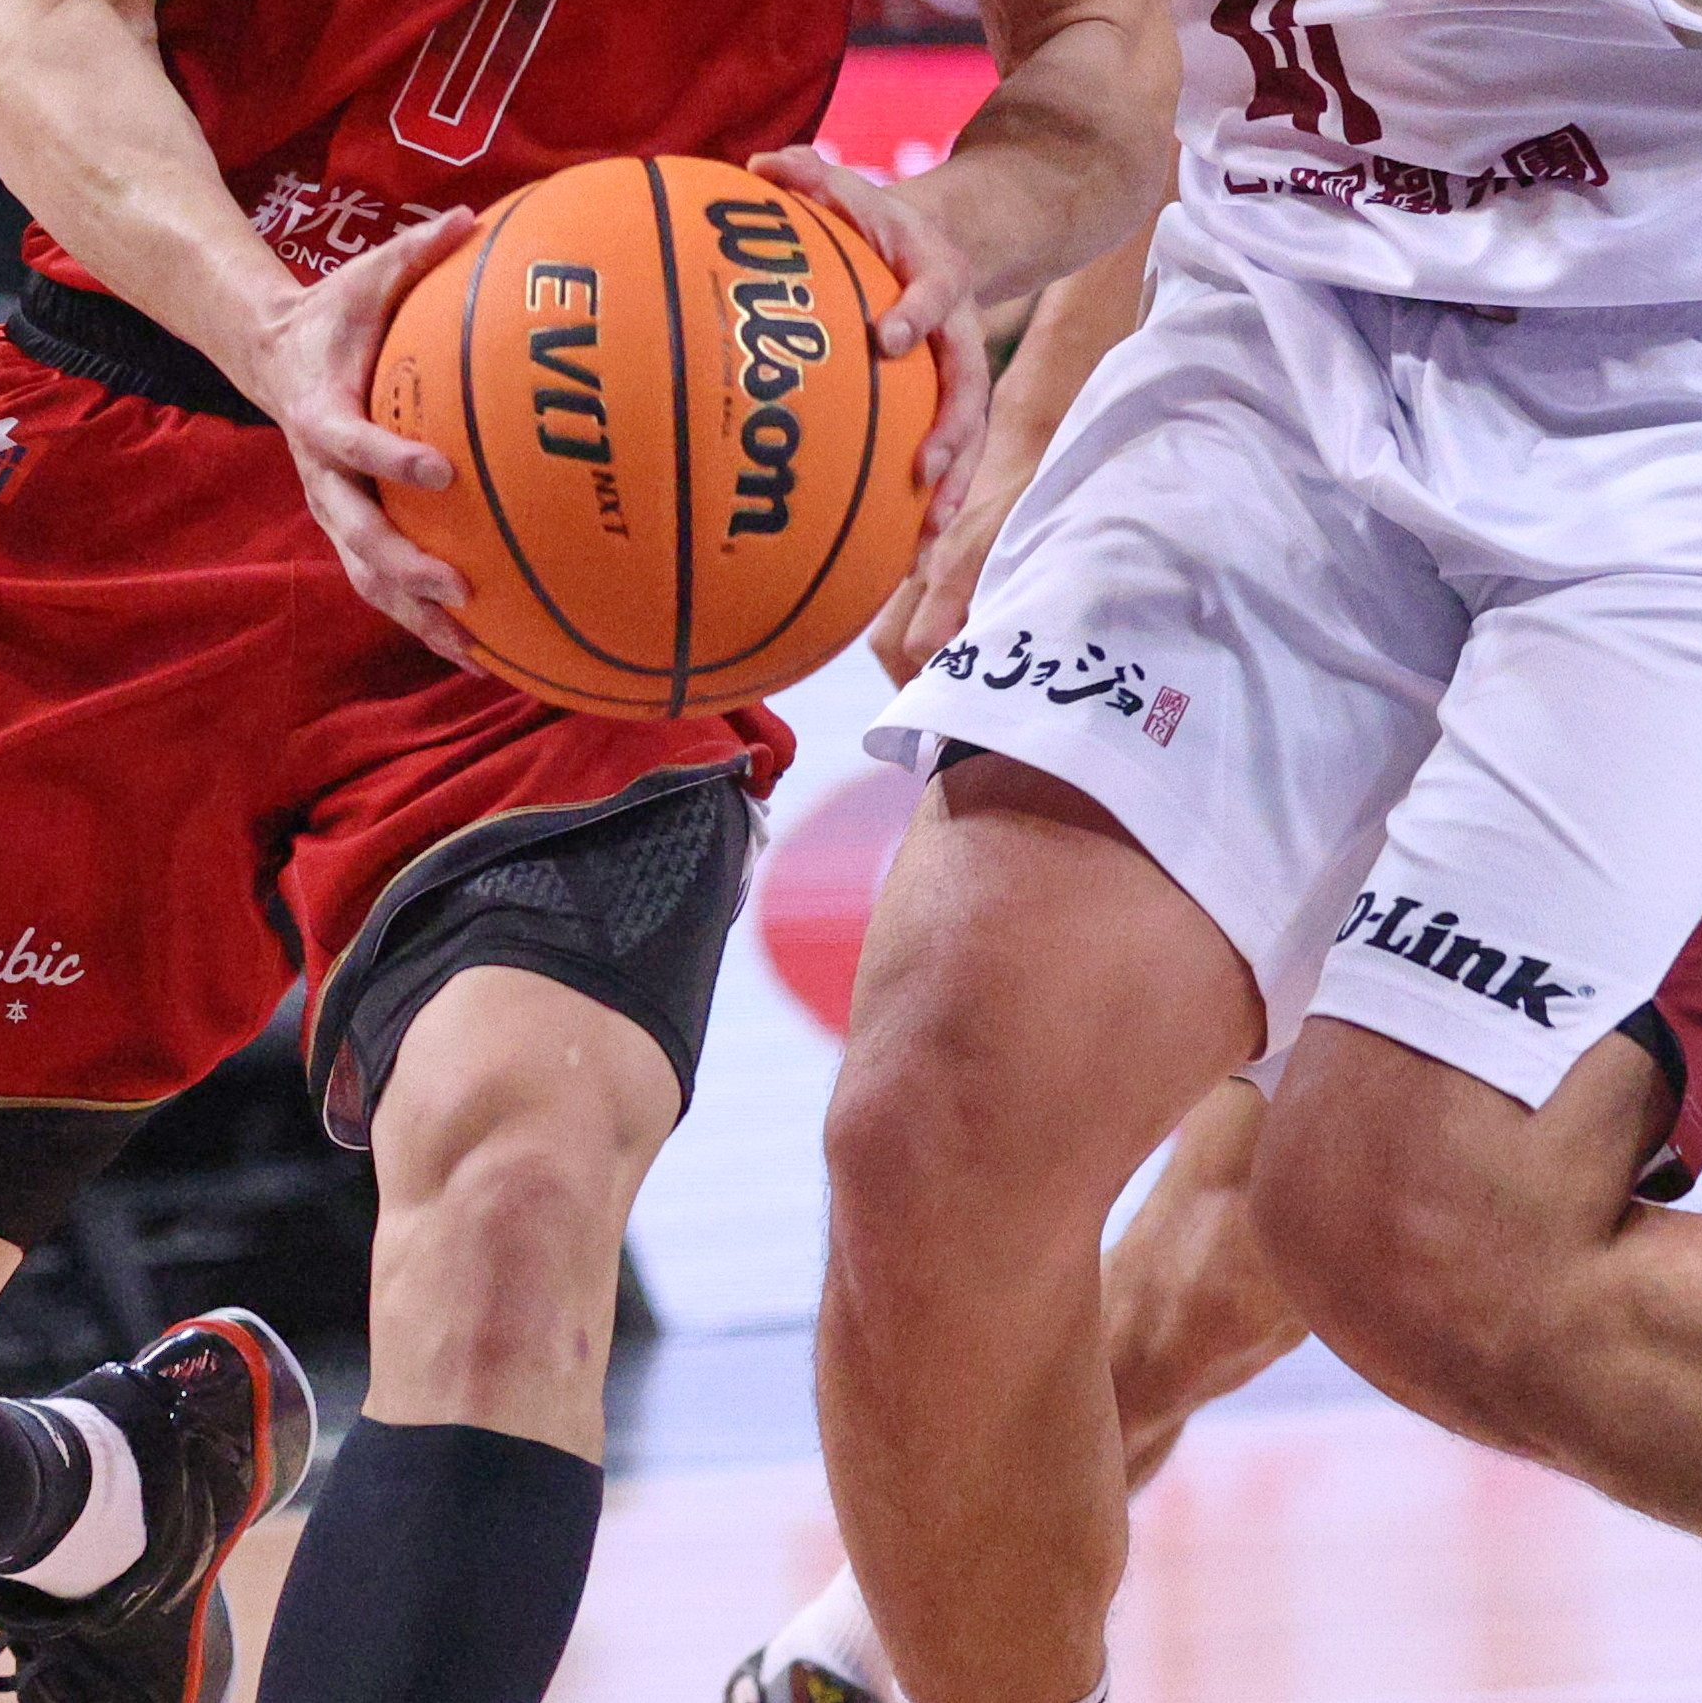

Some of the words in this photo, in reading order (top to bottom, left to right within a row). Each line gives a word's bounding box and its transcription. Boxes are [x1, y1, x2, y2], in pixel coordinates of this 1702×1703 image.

[254, 170, 443, 254] 新光
[277, 240, 344, 276] ONG
[525, 259, 613, 464] EVO
[704, 197, 832, 539] Wilson
